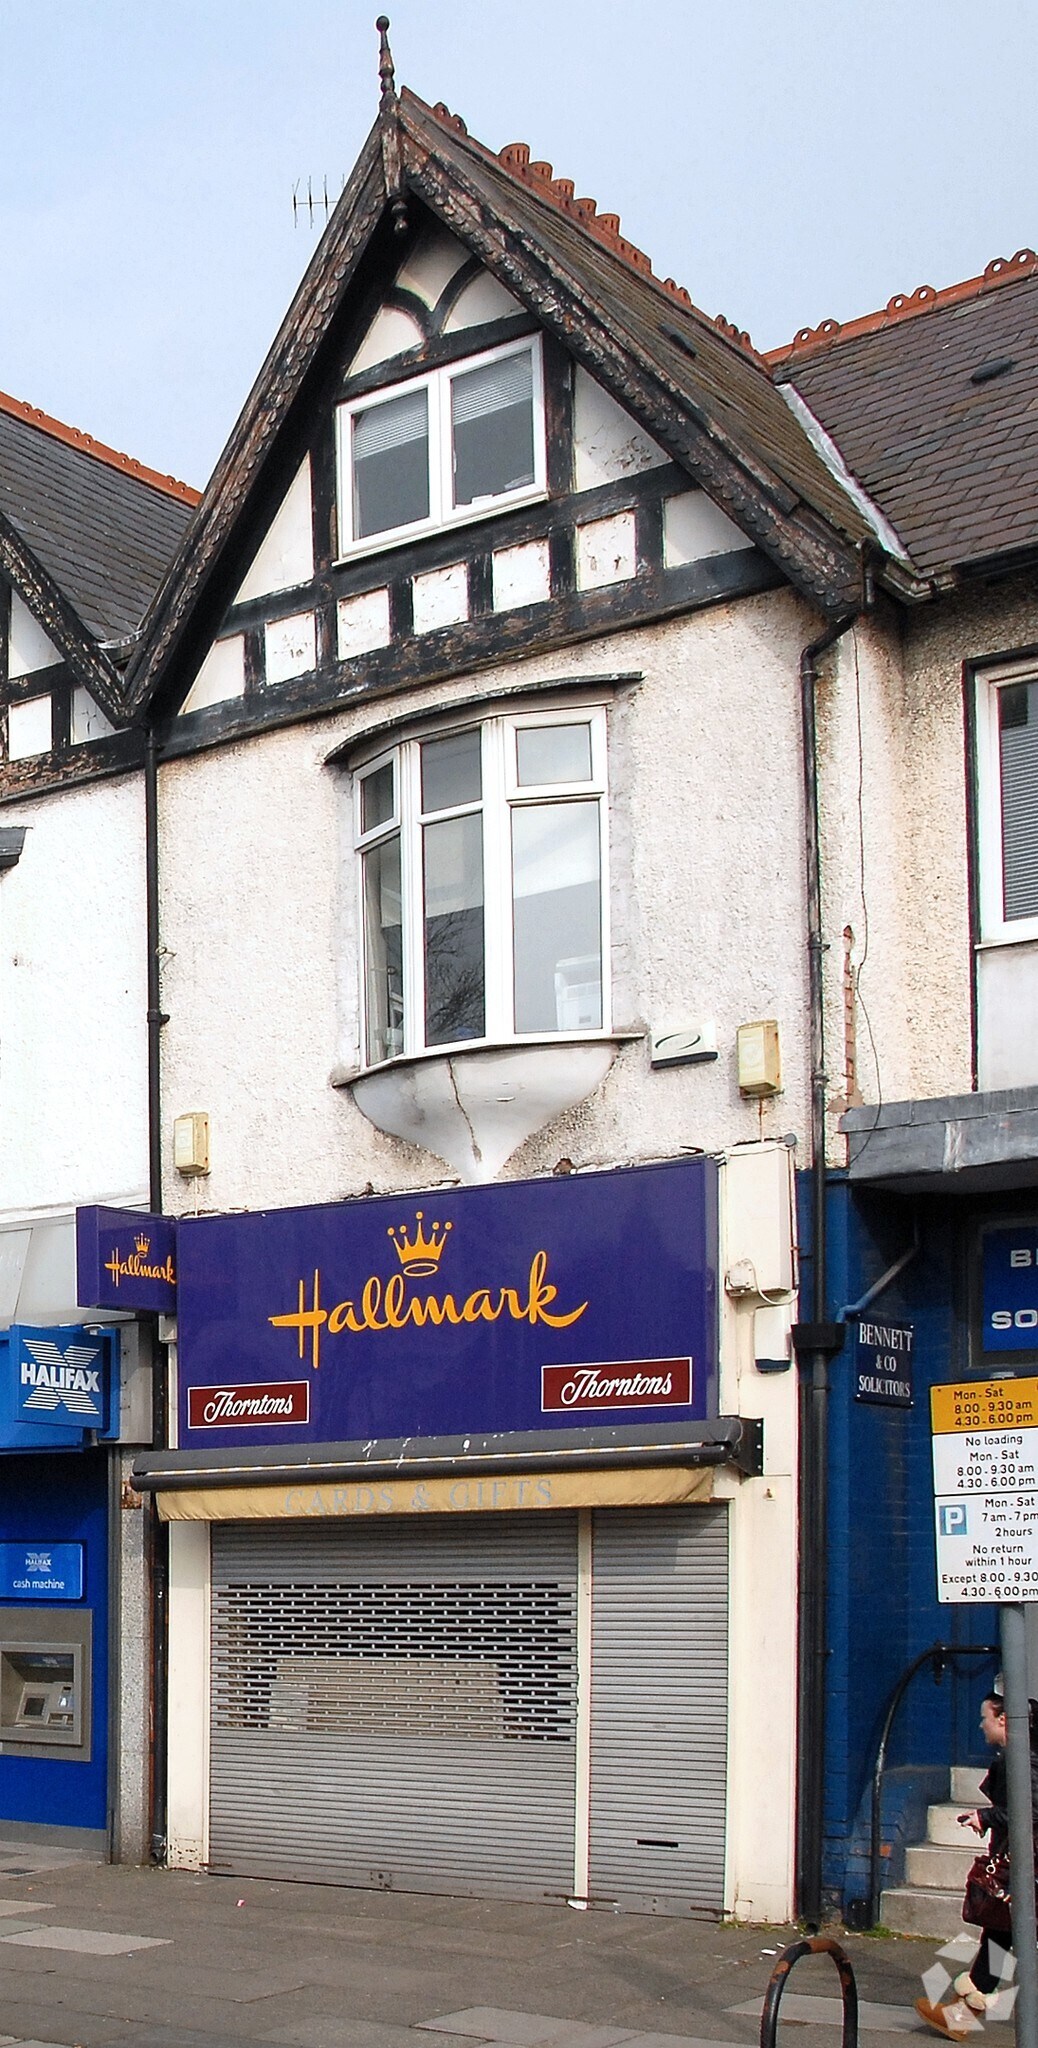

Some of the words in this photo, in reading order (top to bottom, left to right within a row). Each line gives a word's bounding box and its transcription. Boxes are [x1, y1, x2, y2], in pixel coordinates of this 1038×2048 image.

[1010, 1248, 1038, 1267] B
[105, 1247, 177, 1288] Hallmark
[268, 1250, 588, 1369] Hallmark
[859, 1322, 913, 1352] BENNETT
[876, 1355, 882, 1370] &
[883, 1356, 897, 1372] CO
[21, 1362, 100, 1393] HALIFAX
[561, 1369, 672, 1405] Thorntons
[858, 1375, 911, 1398] SOLICITORS
[954, 1391, 976, 1400] Mon
[985, 1388, 1004, 1398] Sat
[204, 1391, 293, 1423] Thorntons
[955, 1404, 980, 1414] 8.00
[988, 1401, 1013, 1412] 9.30
[1016, 1401, 1032, 1409] am
[955, 1416, 980, 1426] 4.30
[989, 1413, 1014, 1424] 6.00
[1016, 1413, 1033, 1423] pm
[966, 1437, 981, 1446] No
[984, 1434, 1023, 1445] loading
[970, 1452, 993, 1461] Mon
[1001, 1450, 1020, 1460] Sat
[957, 1466, 982, 1476] 8.00
[991, 1464, 1015, 1474] 9.30
[1018, 1464, 1034, 1473] am
[957, 1479, 982, 1488] 4.30
[991, 1476, 1016, 1487] 6.00
[1019, 1477, 1036, 1486] pm
[285, 1486, 394, 1514] CARDS
[411, 1484, 432, 1510] &
[449, 1479, 552, 1509] GIFTS
[985, 1498, 1008, 1508] Mon
[1017, 1497, 1035, 1507] Sat
[945, 1507, 964, 1534] P
[973, 1545, 988, 1554] No
[991, 1544, 1024, 1553] return
[965, 1556, 997, 1566] within
[1000, 1557, 1005, 1566] 1
[1008, 1556, 1032, 1566] hour
[13, 1578, 31, 1589] cash
[32, 1579, 65, 1590] machine
[942, 1573, 977, 1584] Except
[980, 1573, 1005, 1583] 8.00
[961, 1587, 986, 1597] 4.30
[994, 1586, 1020, 1597] 6.00
[1022, 1588, 1038, 1597] pm
